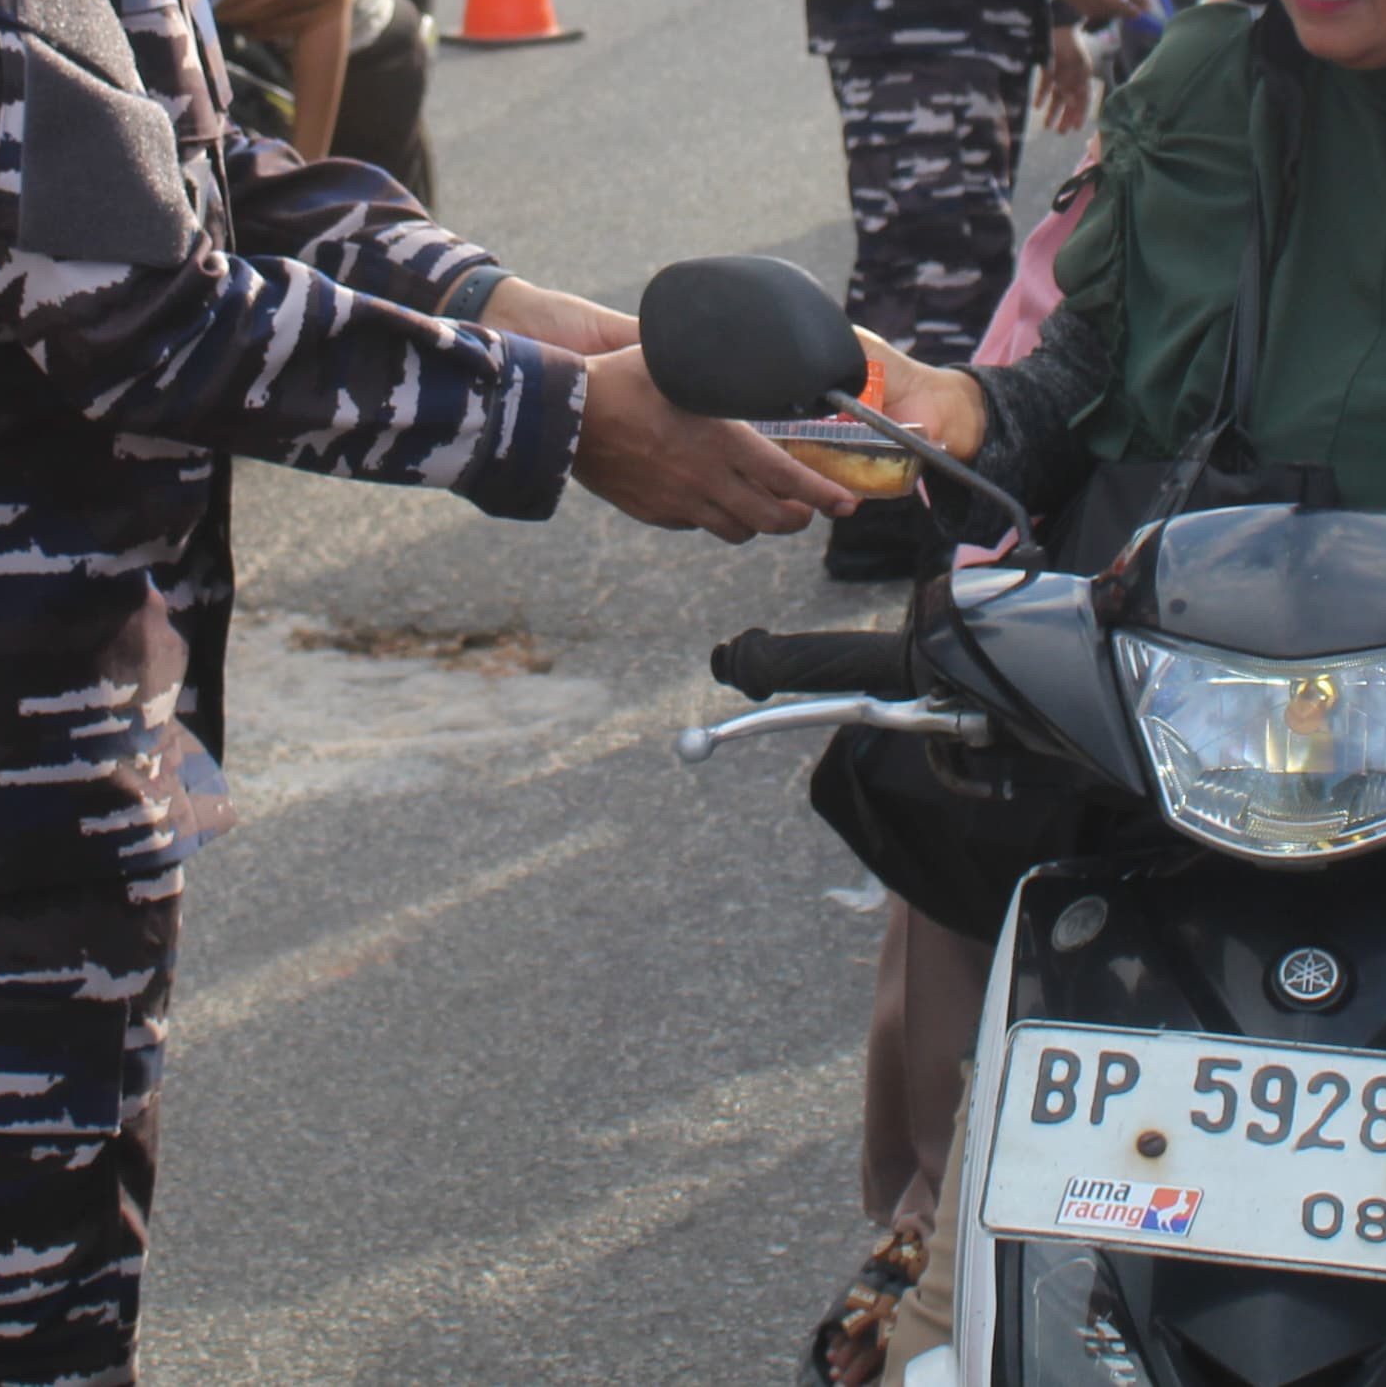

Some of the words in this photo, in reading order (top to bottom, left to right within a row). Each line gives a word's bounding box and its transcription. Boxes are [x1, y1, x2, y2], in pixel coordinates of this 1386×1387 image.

[1031, 1048, 1141, 1125] BP
[1069, 1178, 1132, 1203] uma
[1063, 1200, 1146, 1228] racing
